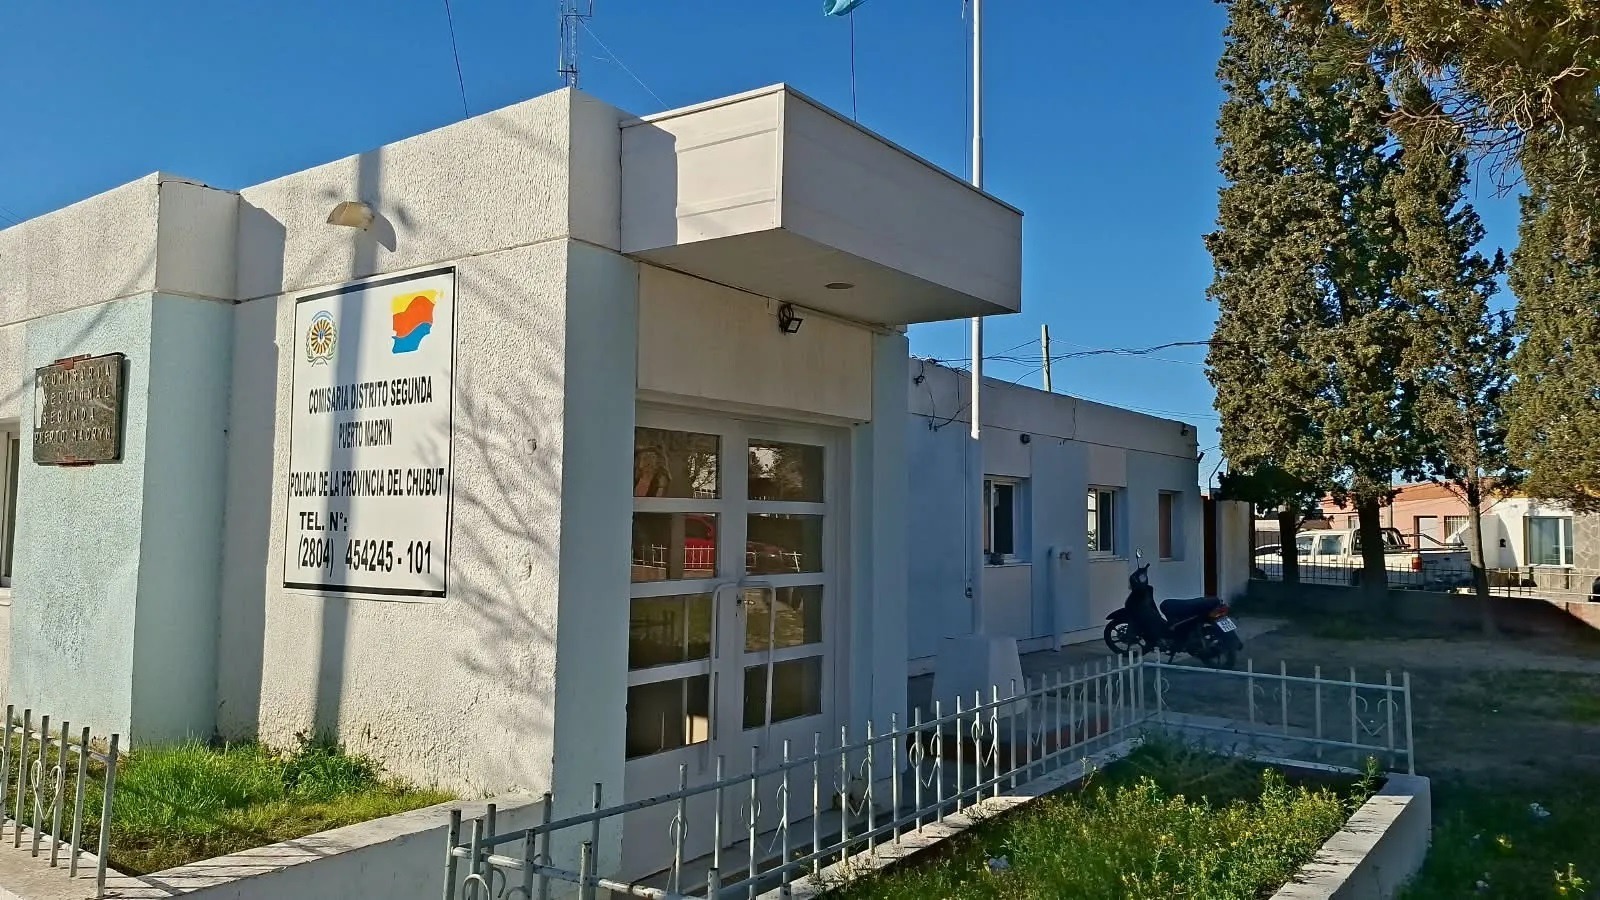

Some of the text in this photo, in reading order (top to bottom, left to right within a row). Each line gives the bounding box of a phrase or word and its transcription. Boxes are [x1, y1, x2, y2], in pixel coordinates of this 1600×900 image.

[43, 363, 112, 386] COMISARIA
[43, 385, 110, 405] SECCIONAL
[308, 375, 433, 415] COMISARIA DISTRITO SEGUNDA
[42, 406, 95, 425] SEGUNDA
[34, 426, 112, 445] PUERTO MADRYN
[338, 418, 393, 449] PUERTO MADRYN
[289, 467, 445, 498] POLICIA DE LA PROVINCIA DEL CHUBUT
[299, 511, 325, 531] TEL.
[297, 534, 334, 577] (2804)
[345, 539, 394, 573] 454245
[406, 541, 432, 574] 101
